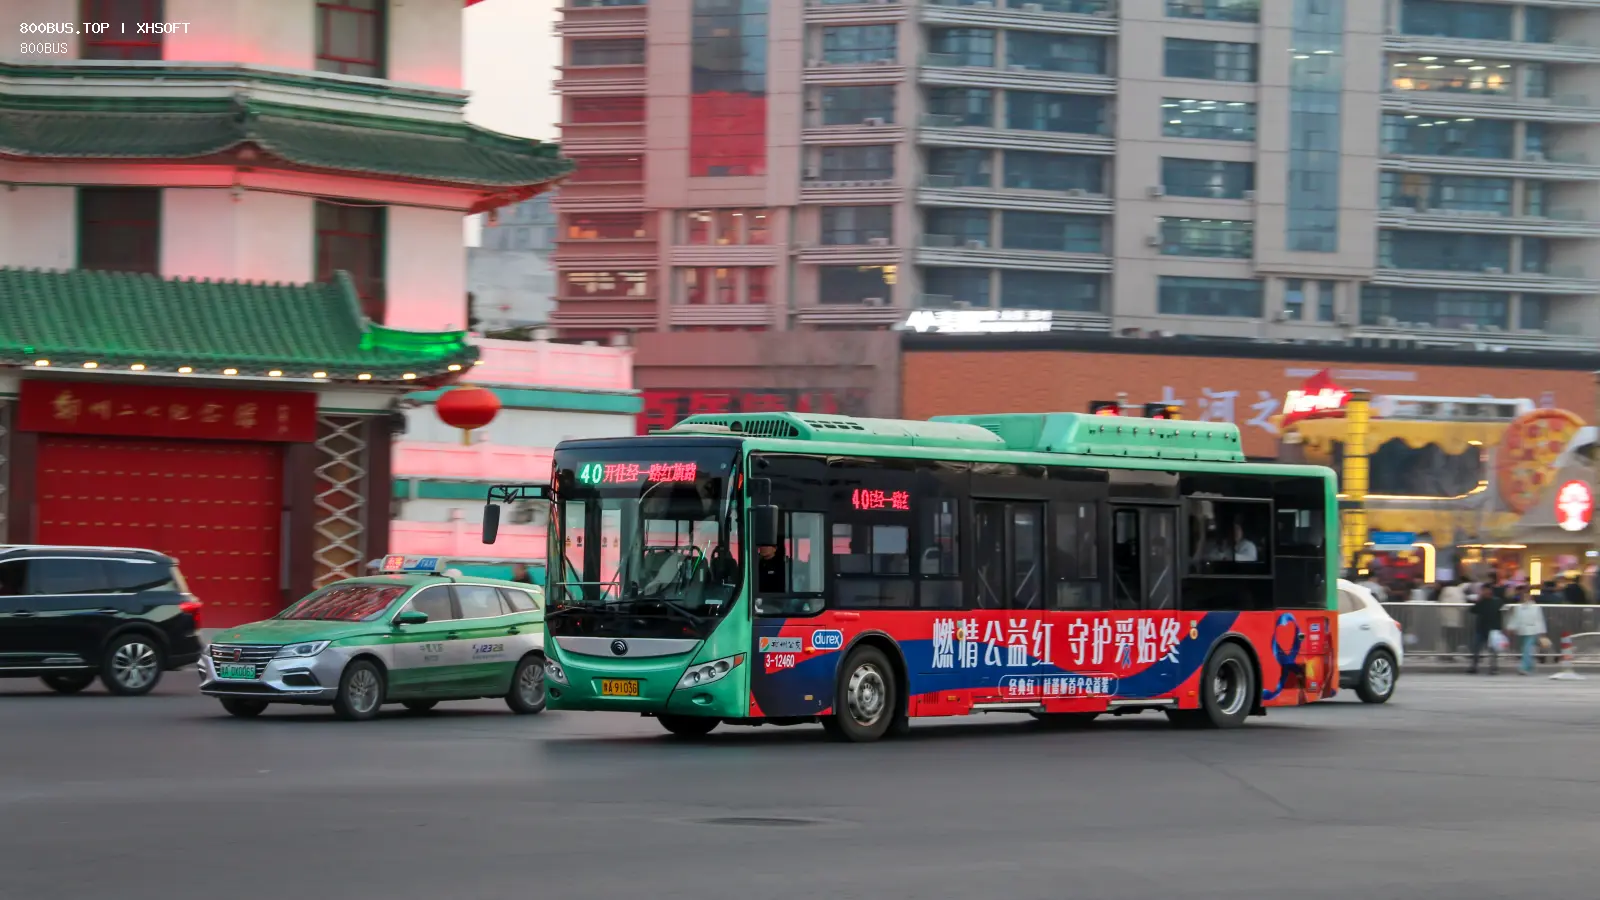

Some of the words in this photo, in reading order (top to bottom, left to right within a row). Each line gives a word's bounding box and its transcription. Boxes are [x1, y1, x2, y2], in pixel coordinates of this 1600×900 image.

[580, 463, 603, 484] 40
[852, 489, 870, 510] 40
[814, 632, 840, 646] durex
[931, 617, 1055, 669] 燃情公益红
[1067, 617, 1181, 667] 守护爱始终
[765, 653, 795, 668] 3-12460
[1008, 678, 1035, 696] 经典红
